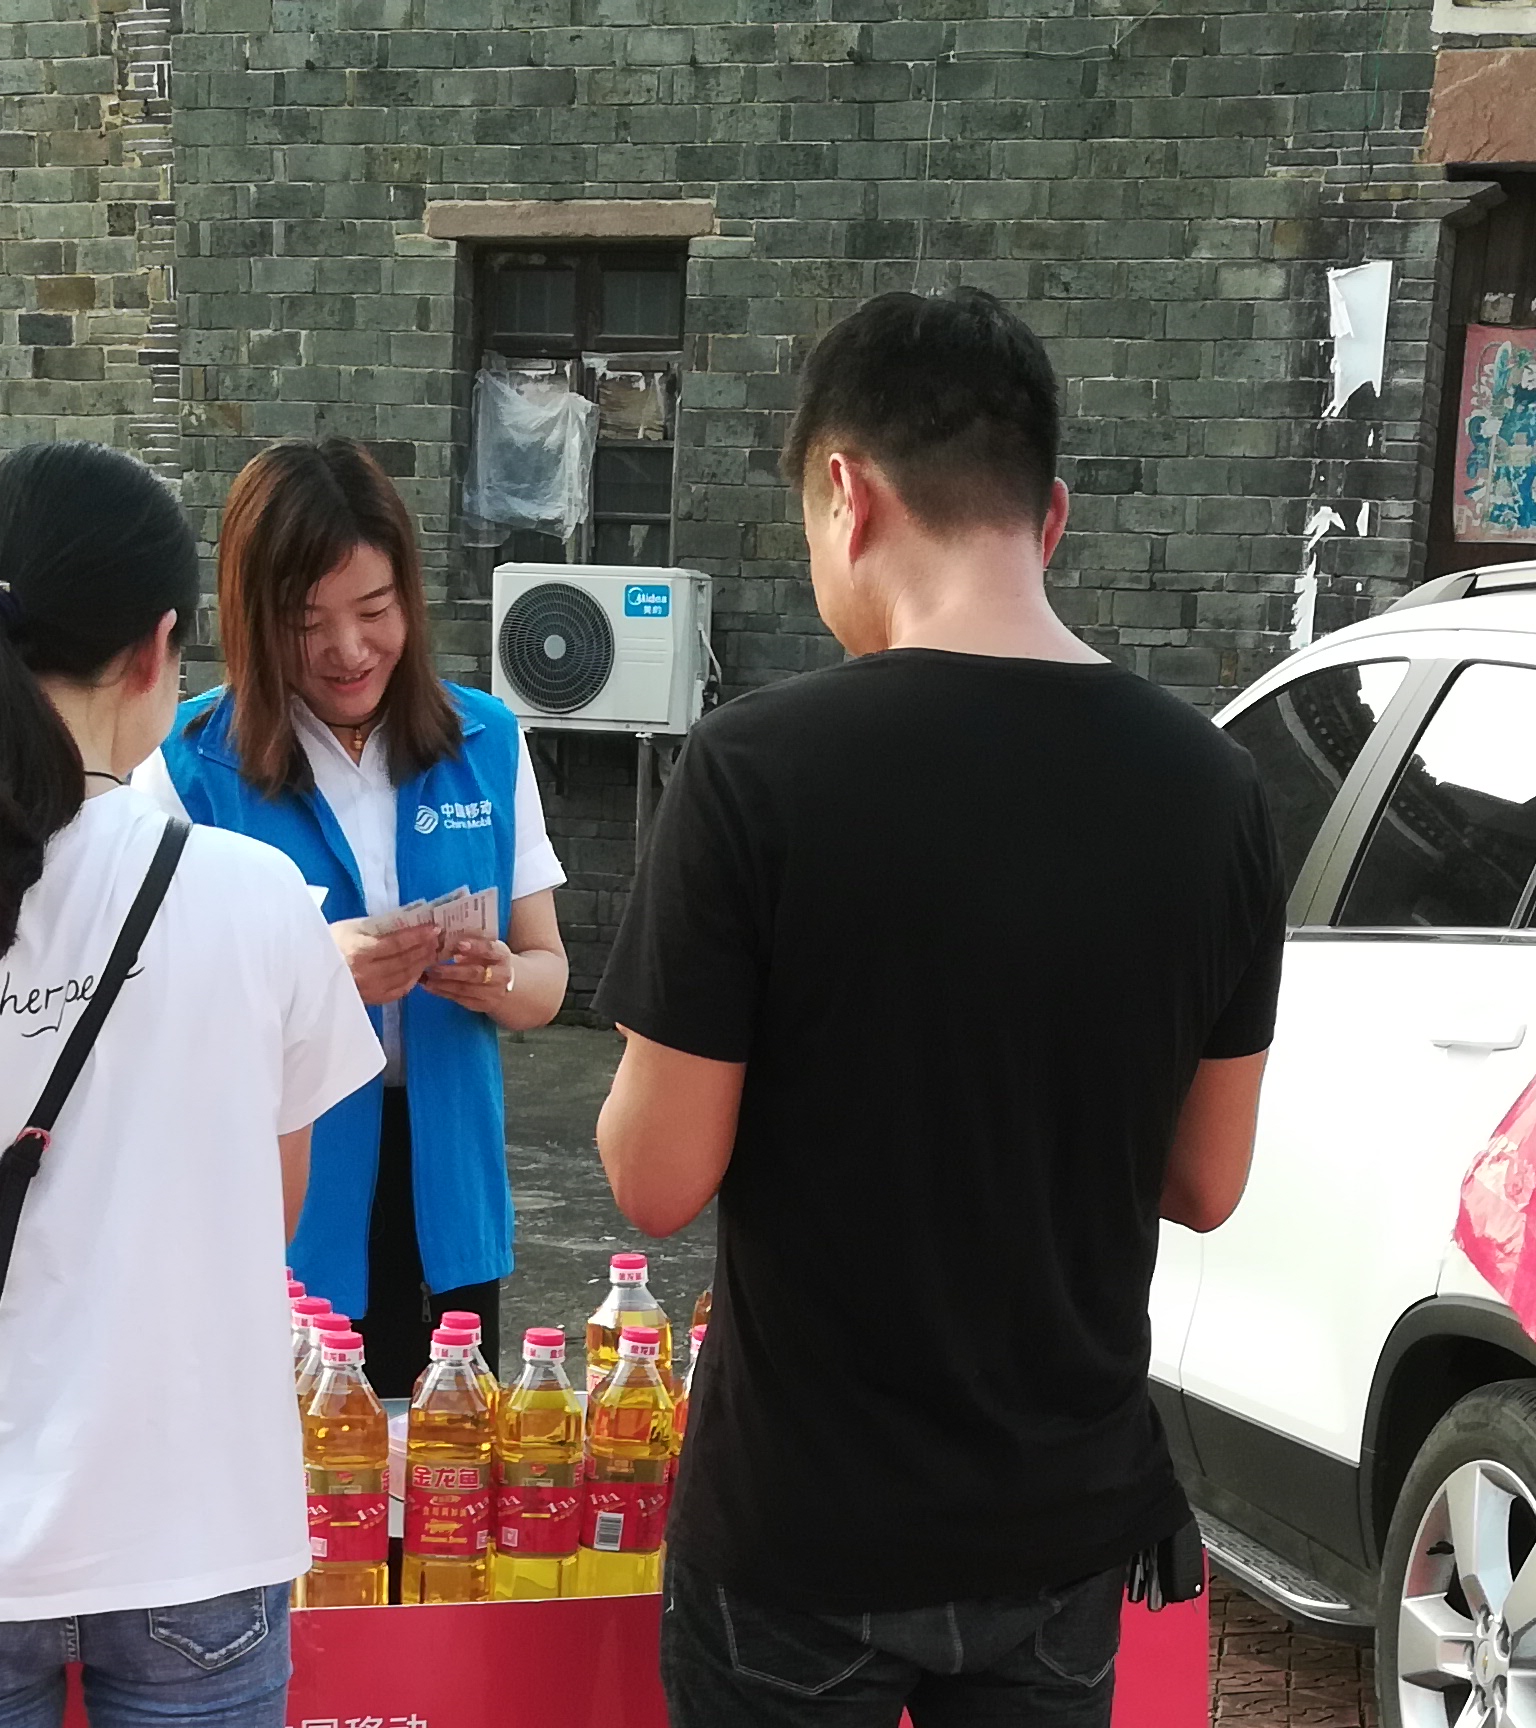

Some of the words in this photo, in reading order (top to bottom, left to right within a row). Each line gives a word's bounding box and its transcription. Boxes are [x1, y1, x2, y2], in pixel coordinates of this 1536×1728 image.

[628, 587, 667, 605] Midea
[441, 799, 492, 819] 中国移动
[412, 1465, 480, 1489] 金龙鱼
